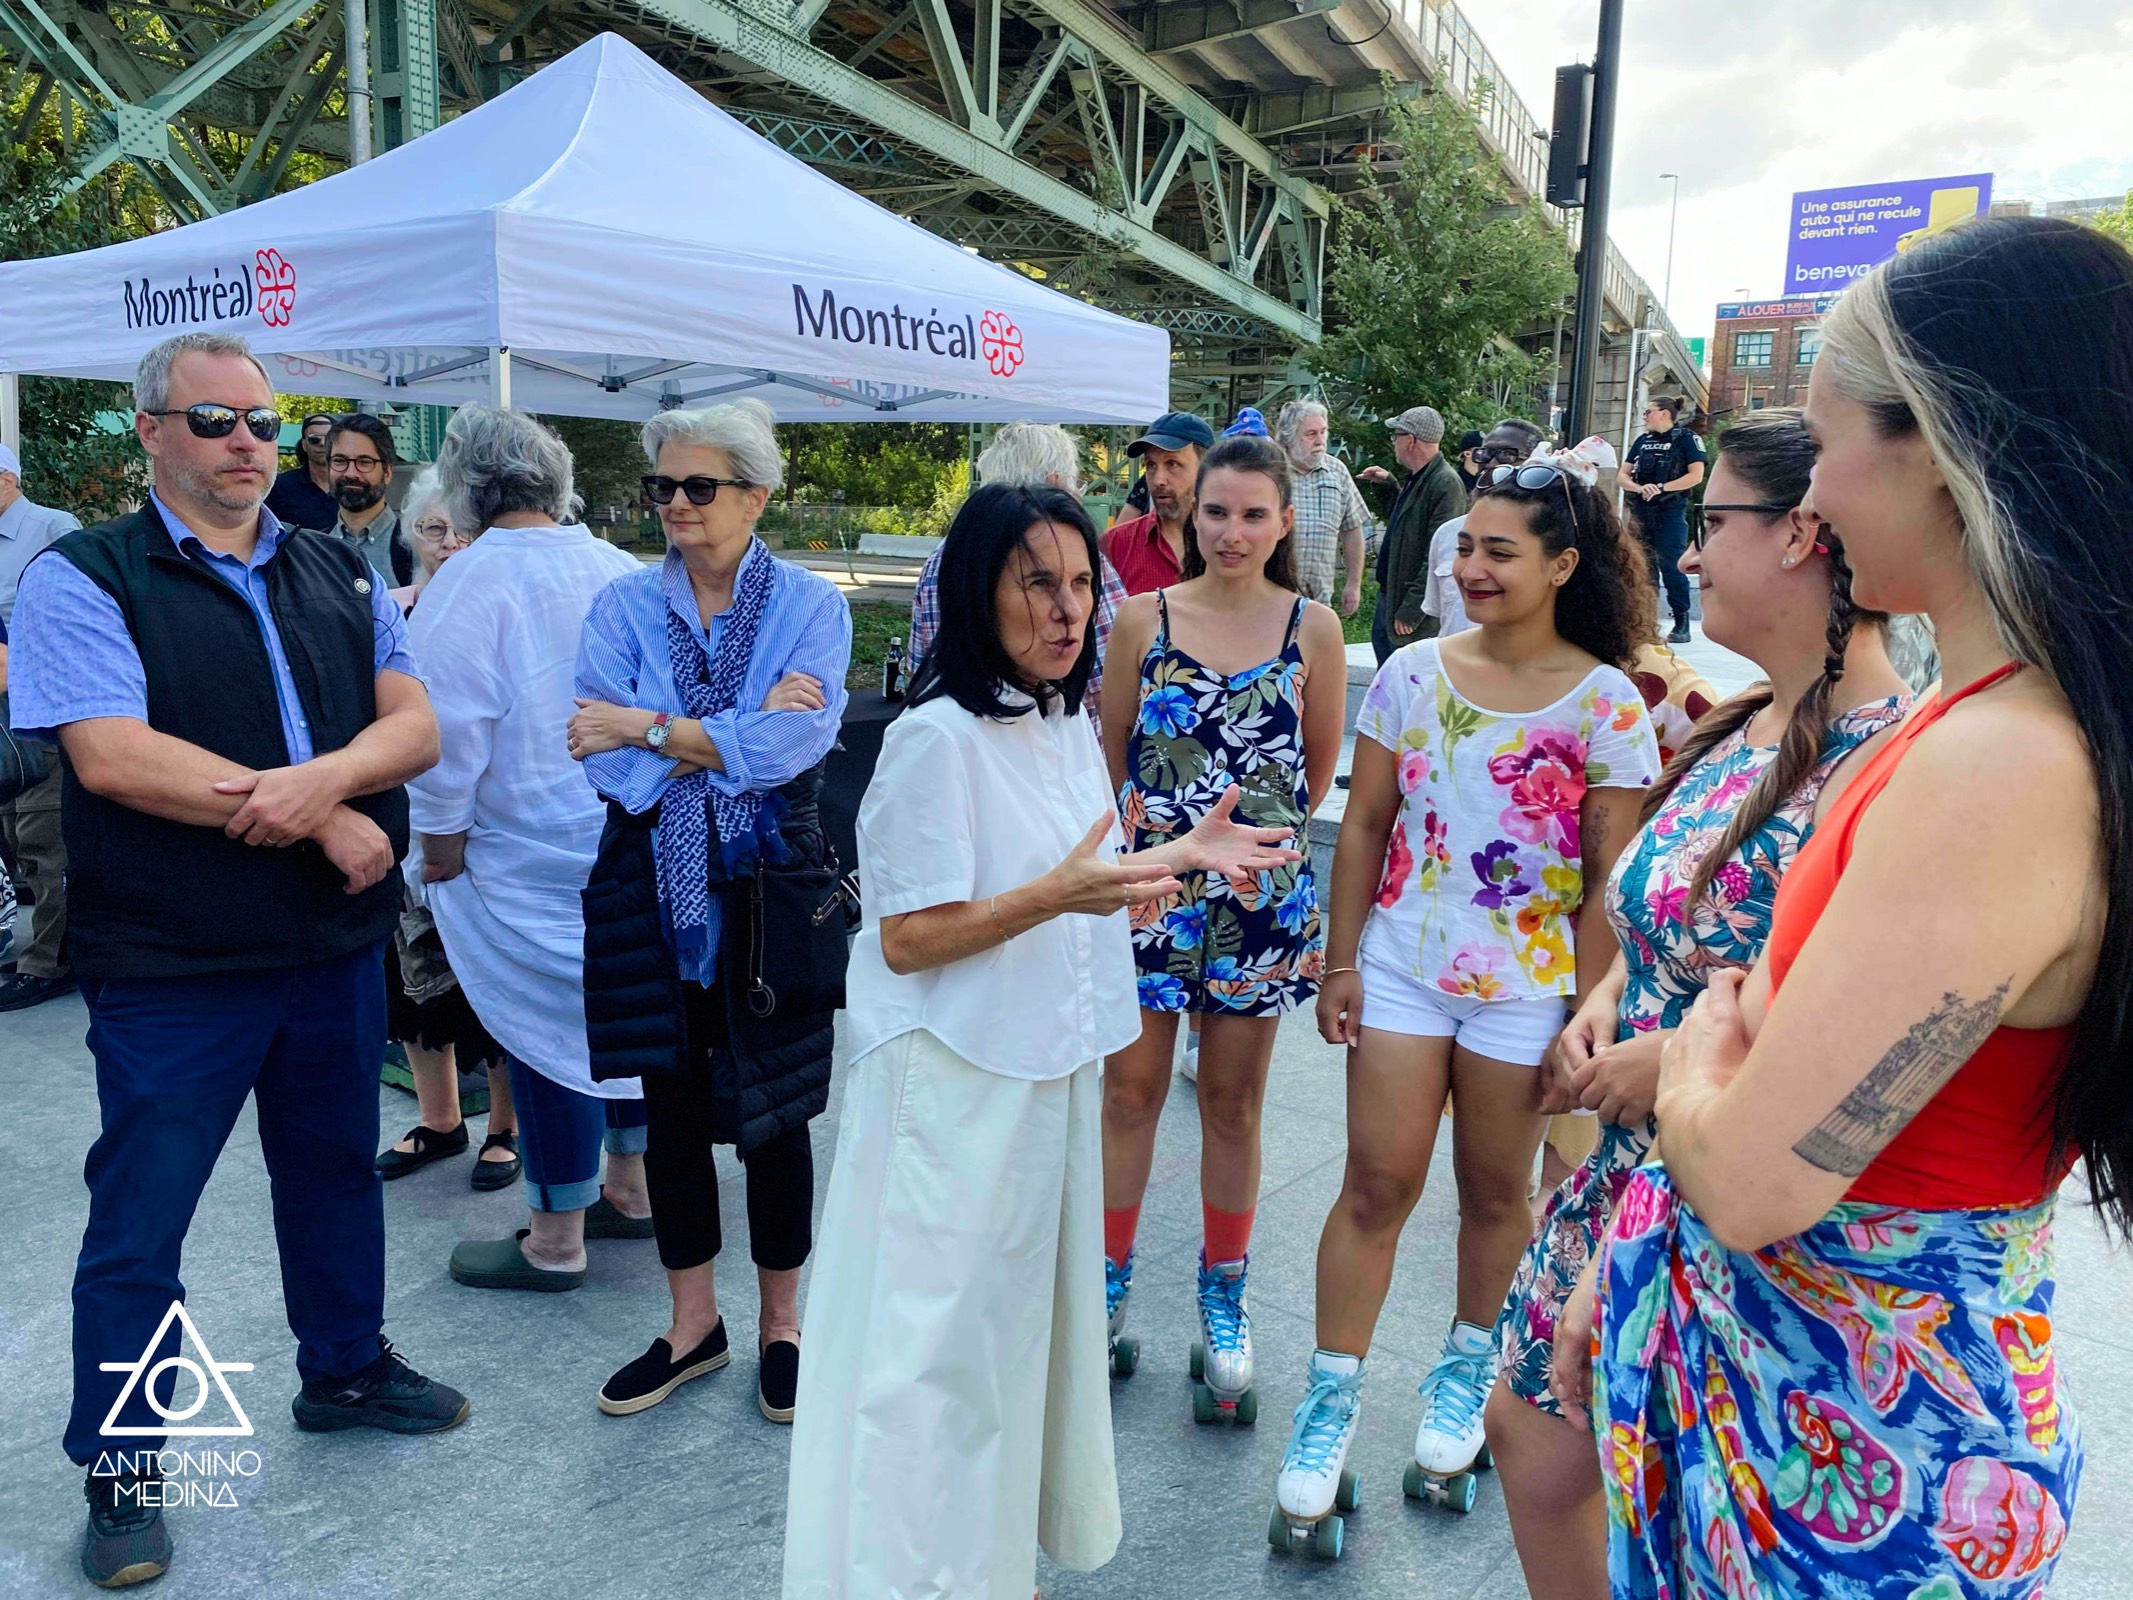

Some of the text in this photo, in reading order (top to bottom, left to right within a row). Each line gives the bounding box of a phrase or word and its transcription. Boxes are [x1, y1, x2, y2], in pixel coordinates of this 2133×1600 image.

[1801, 196, 1902, 213] Une assurance
[1800, 206, 1921, 227] auto qui ne recule
[1799, 223, 1878, 240] devant rien.
[1795, 264, 1871, 281] beneva
[123, 264, 253, 329] Montréal
[1747, 303, 1785, 316] LOUER
[792, 283, 977, 361] Montréal
